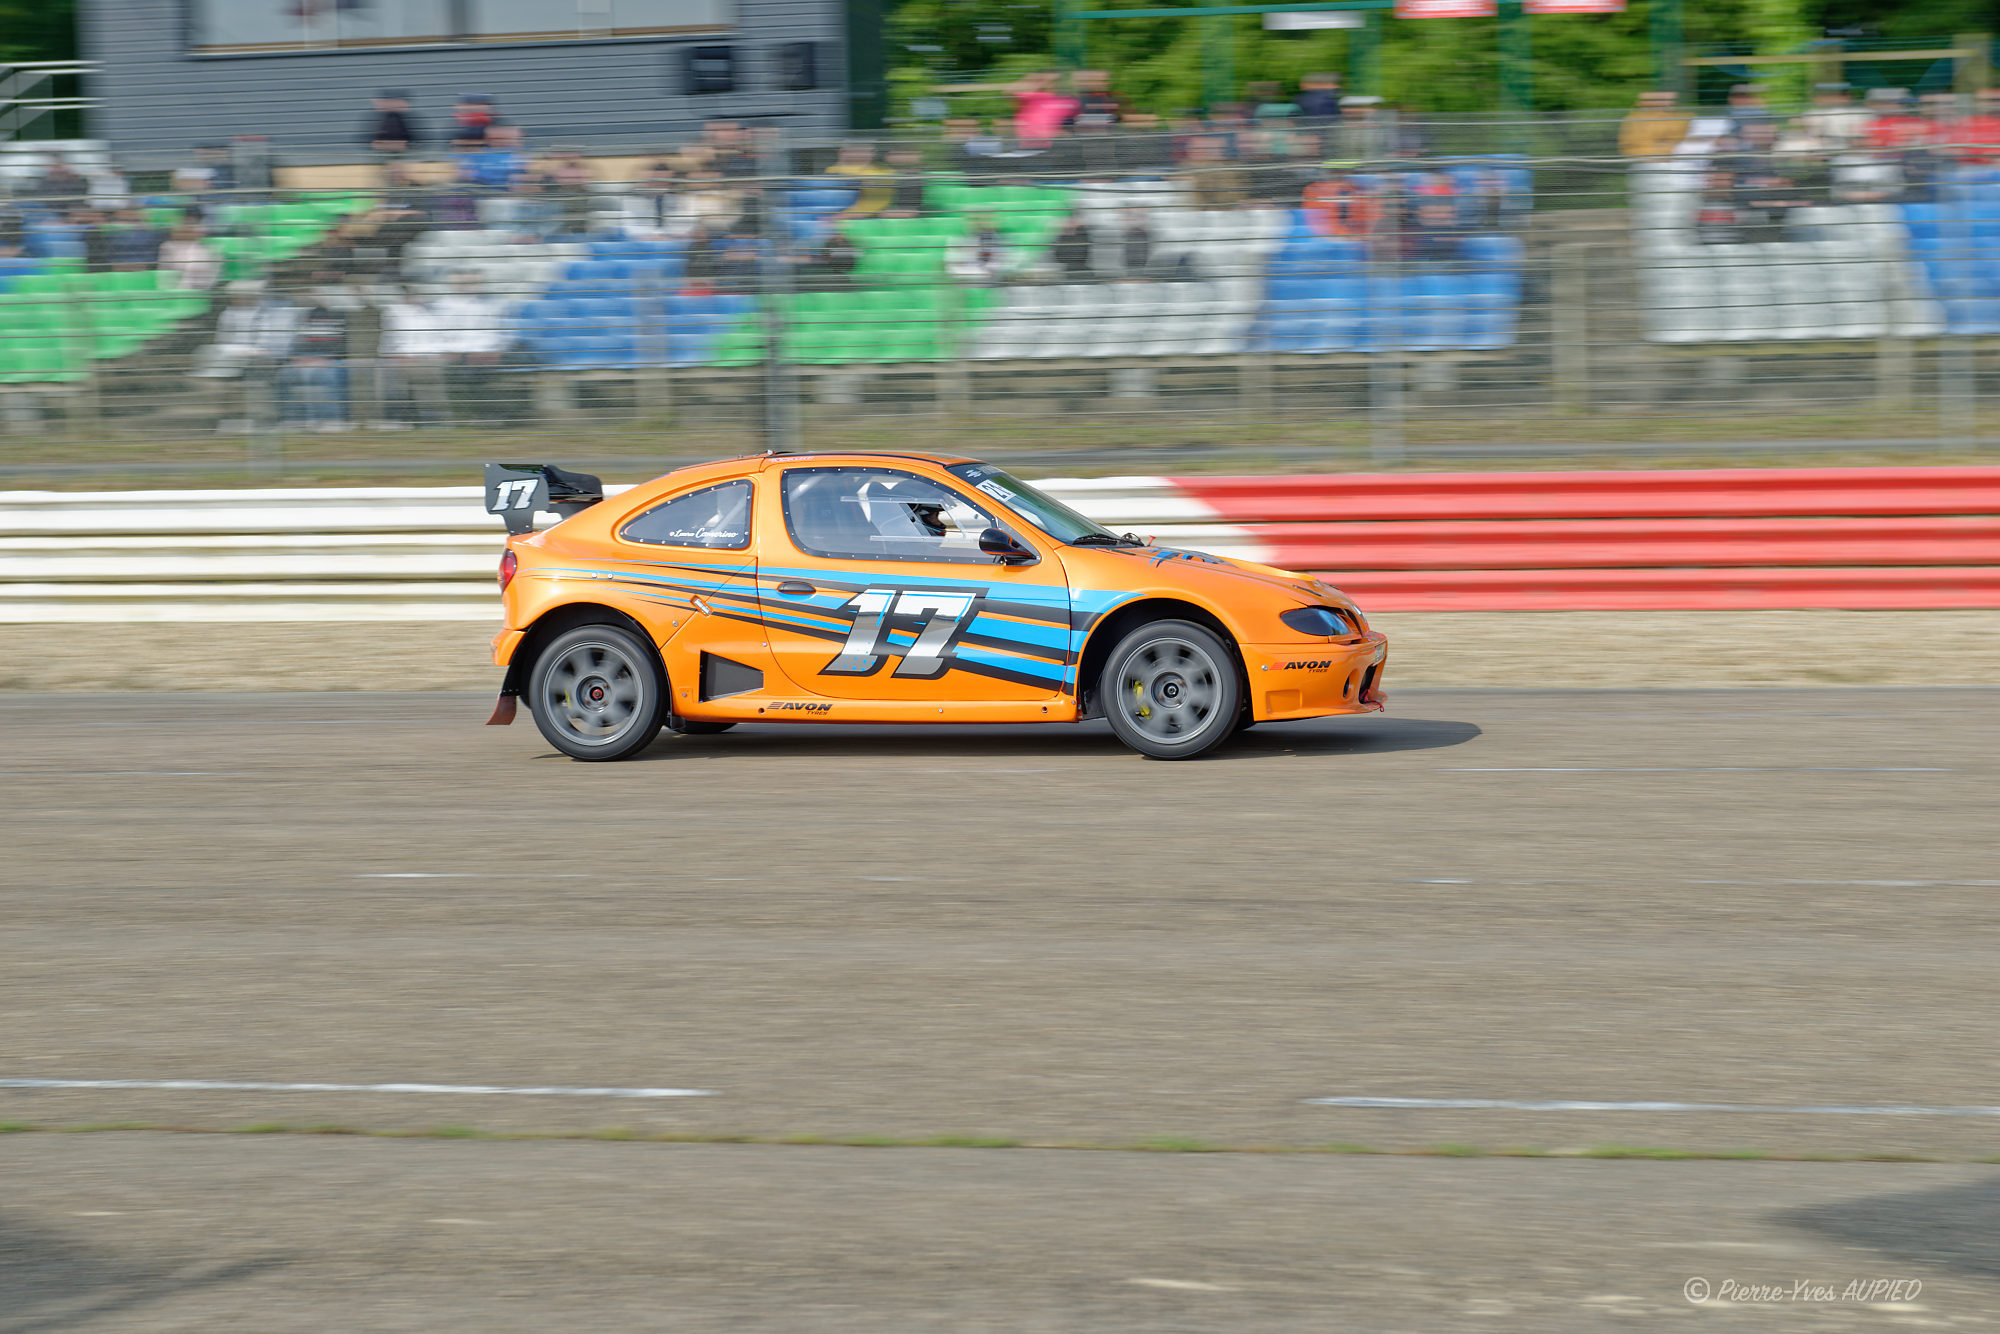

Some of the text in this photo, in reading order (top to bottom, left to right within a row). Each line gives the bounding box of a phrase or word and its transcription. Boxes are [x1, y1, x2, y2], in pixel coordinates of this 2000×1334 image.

[491, 479, 539, 511] 17
[821, 586, 980, 678] 17
[1284, 660, 1332, 670] AVON
[781, 702, 833, 711] AVON
